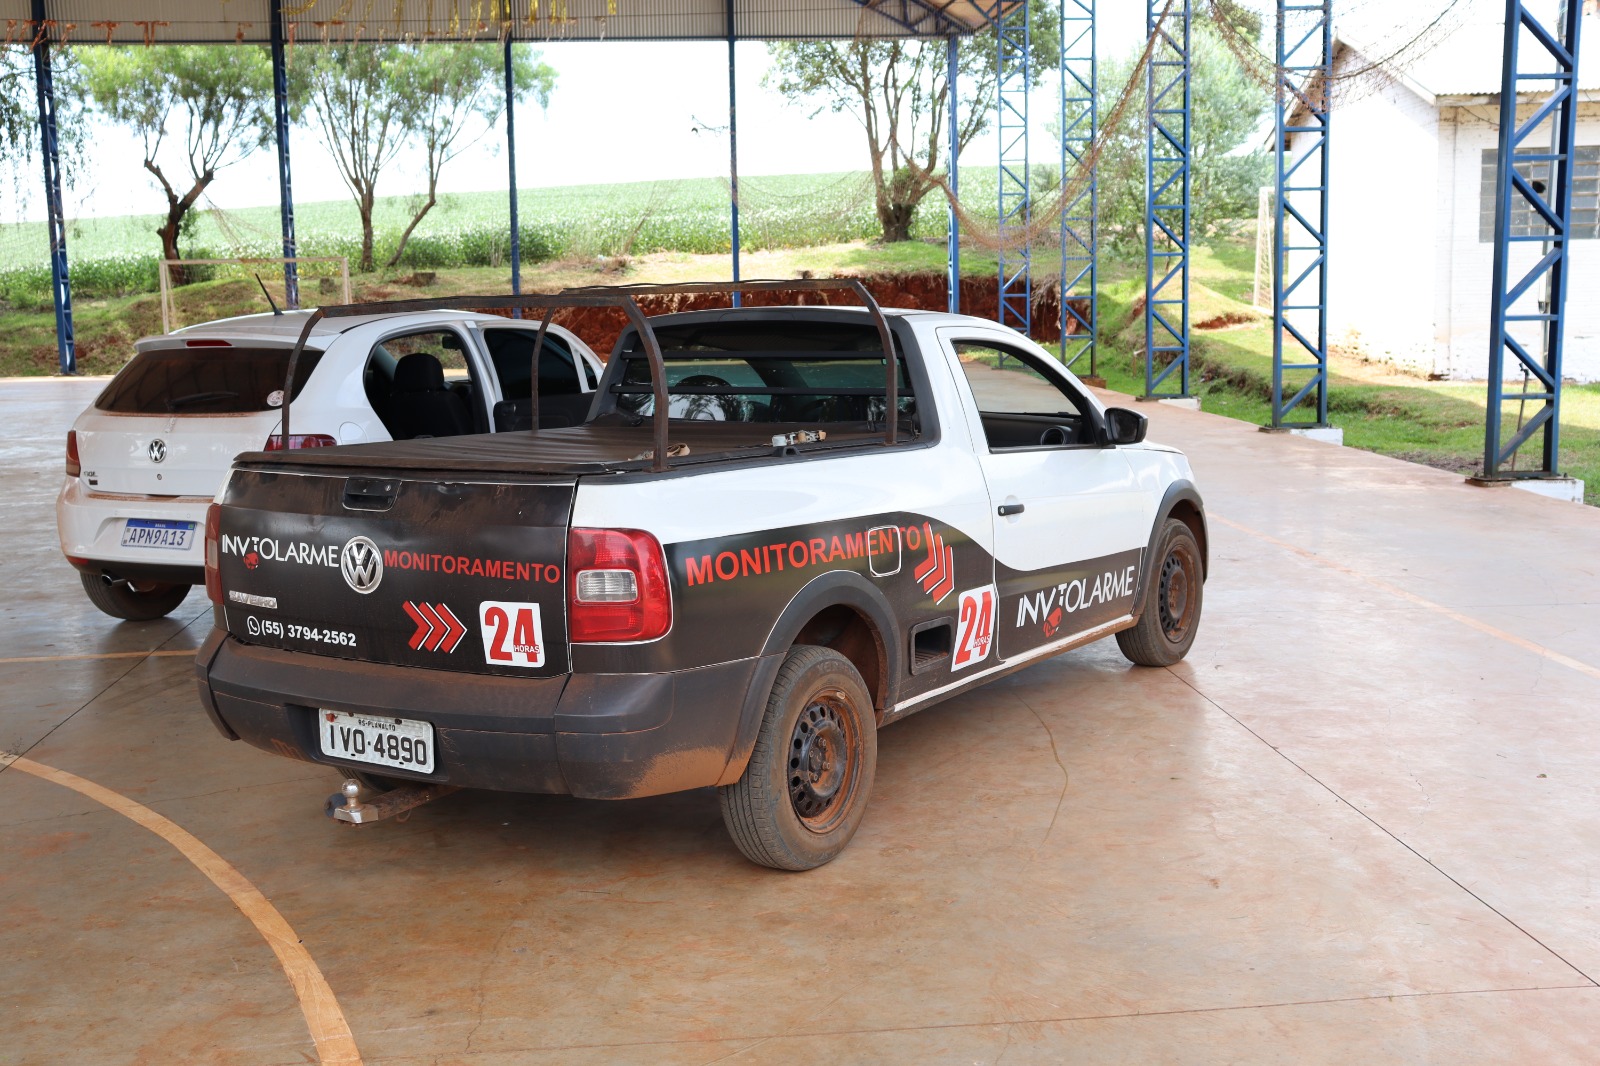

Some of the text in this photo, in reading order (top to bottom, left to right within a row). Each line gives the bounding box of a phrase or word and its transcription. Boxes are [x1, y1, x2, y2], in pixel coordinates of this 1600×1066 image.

[129, 528, 186, 546] APN9A13
[384, 550, 561, 584] MONITORAMENTO
[685, 525, 921, 586] MONITORAMENTO
[262, 619, 357, 647] (55) 3794-2562
[485, 606, 538, 662] 24
[955, 591, 992, 665] 24
[513, 644, 540, 654] HORAS
